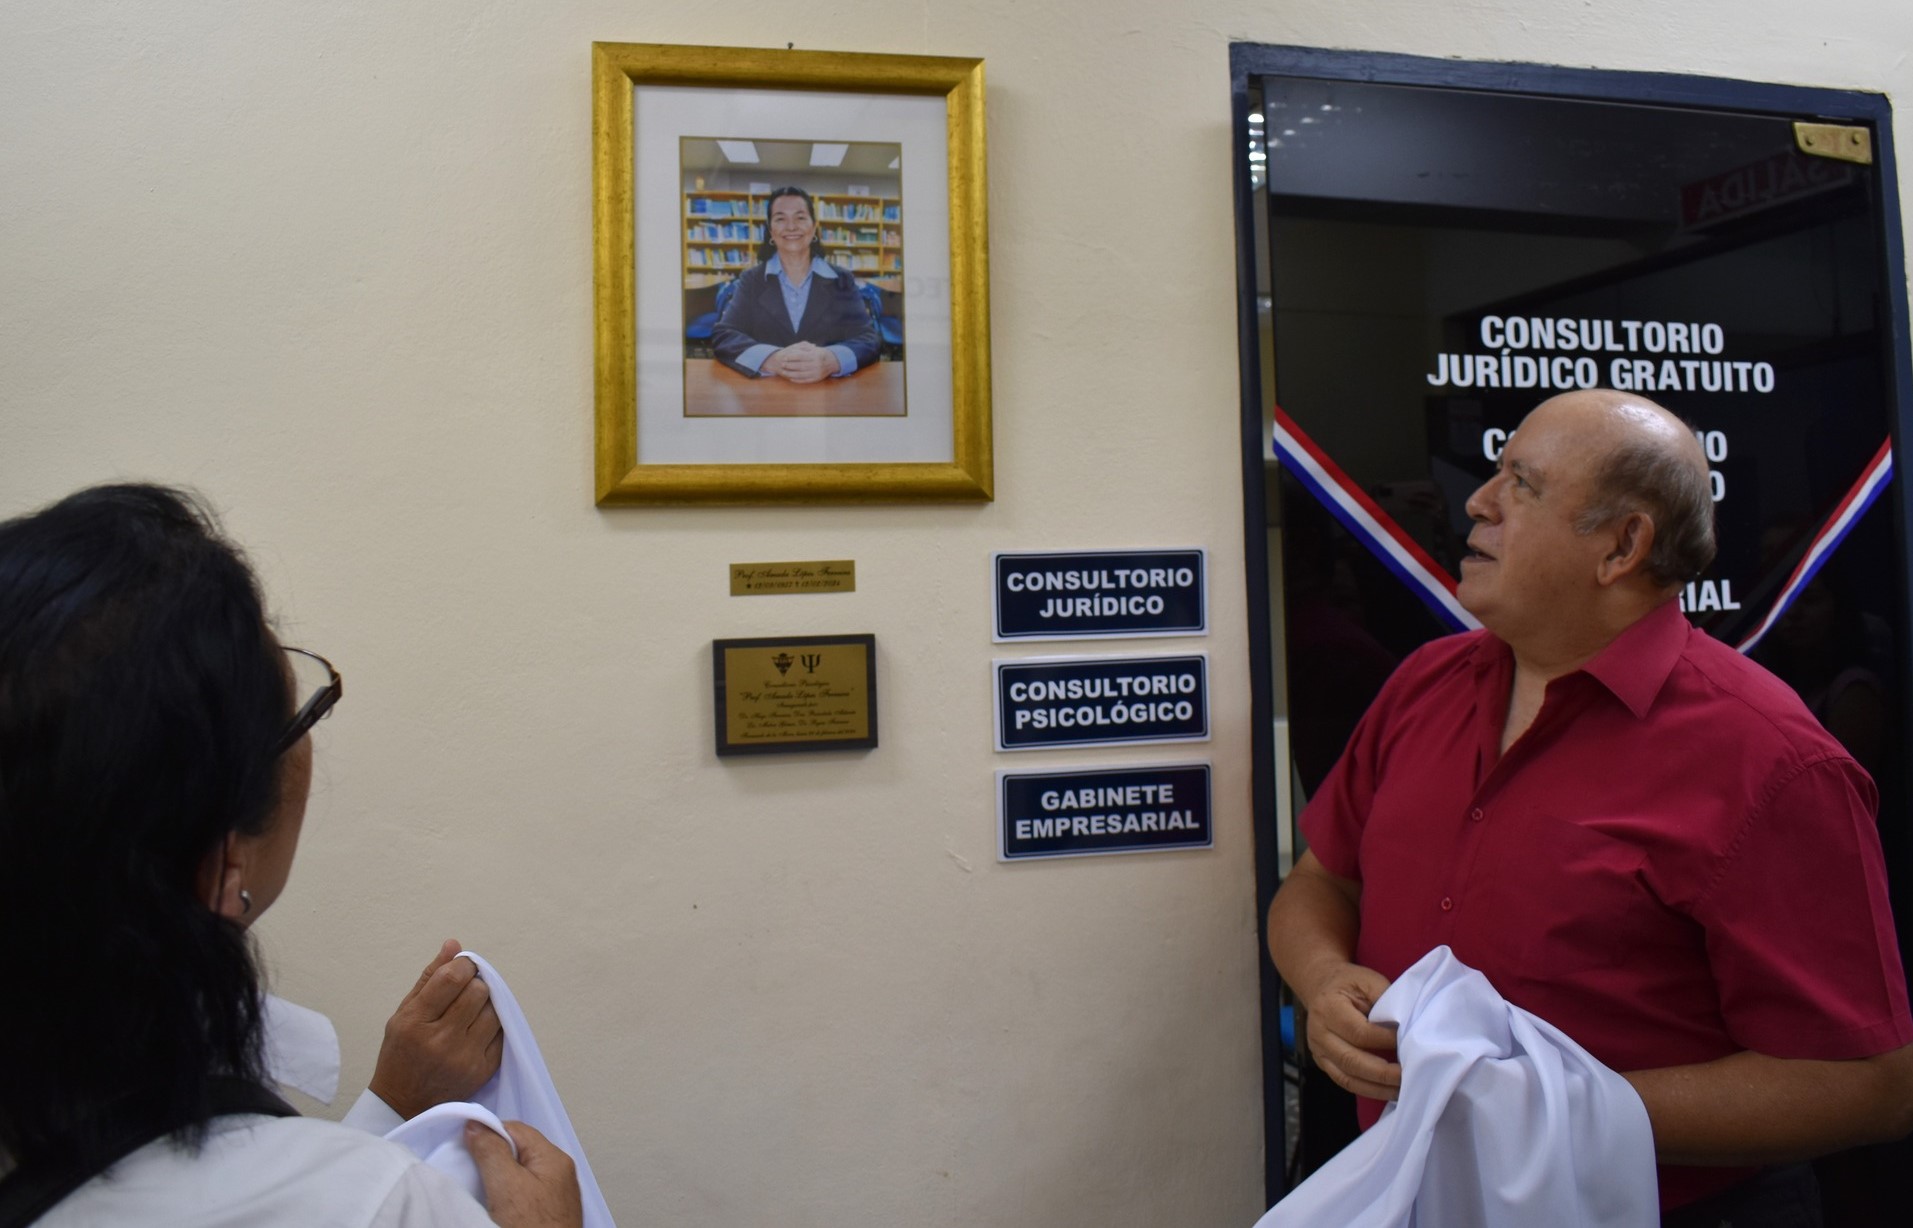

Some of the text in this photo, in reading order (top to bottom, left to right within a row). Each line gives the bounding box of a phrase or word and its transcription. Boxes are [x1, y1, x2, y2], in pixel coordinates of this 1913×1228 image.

[1480, 315, 1724, 354] CONSULTORIO
[1427, 348, 1775, 393] JURÍDICO GRATUITO
[1007, 568, 1194, 592] CONSULTORIO
[1039, 593, 1164, 618] JURÍDICO
[1010, 674, 1196, 702] CONSULTORIO
[1015, 701, 1193, 729] PSICOLÓGICO
[1041, 784, 1174, 811] GABINETE
[1016, 810, 1200, 840] EMPRESARIAL
